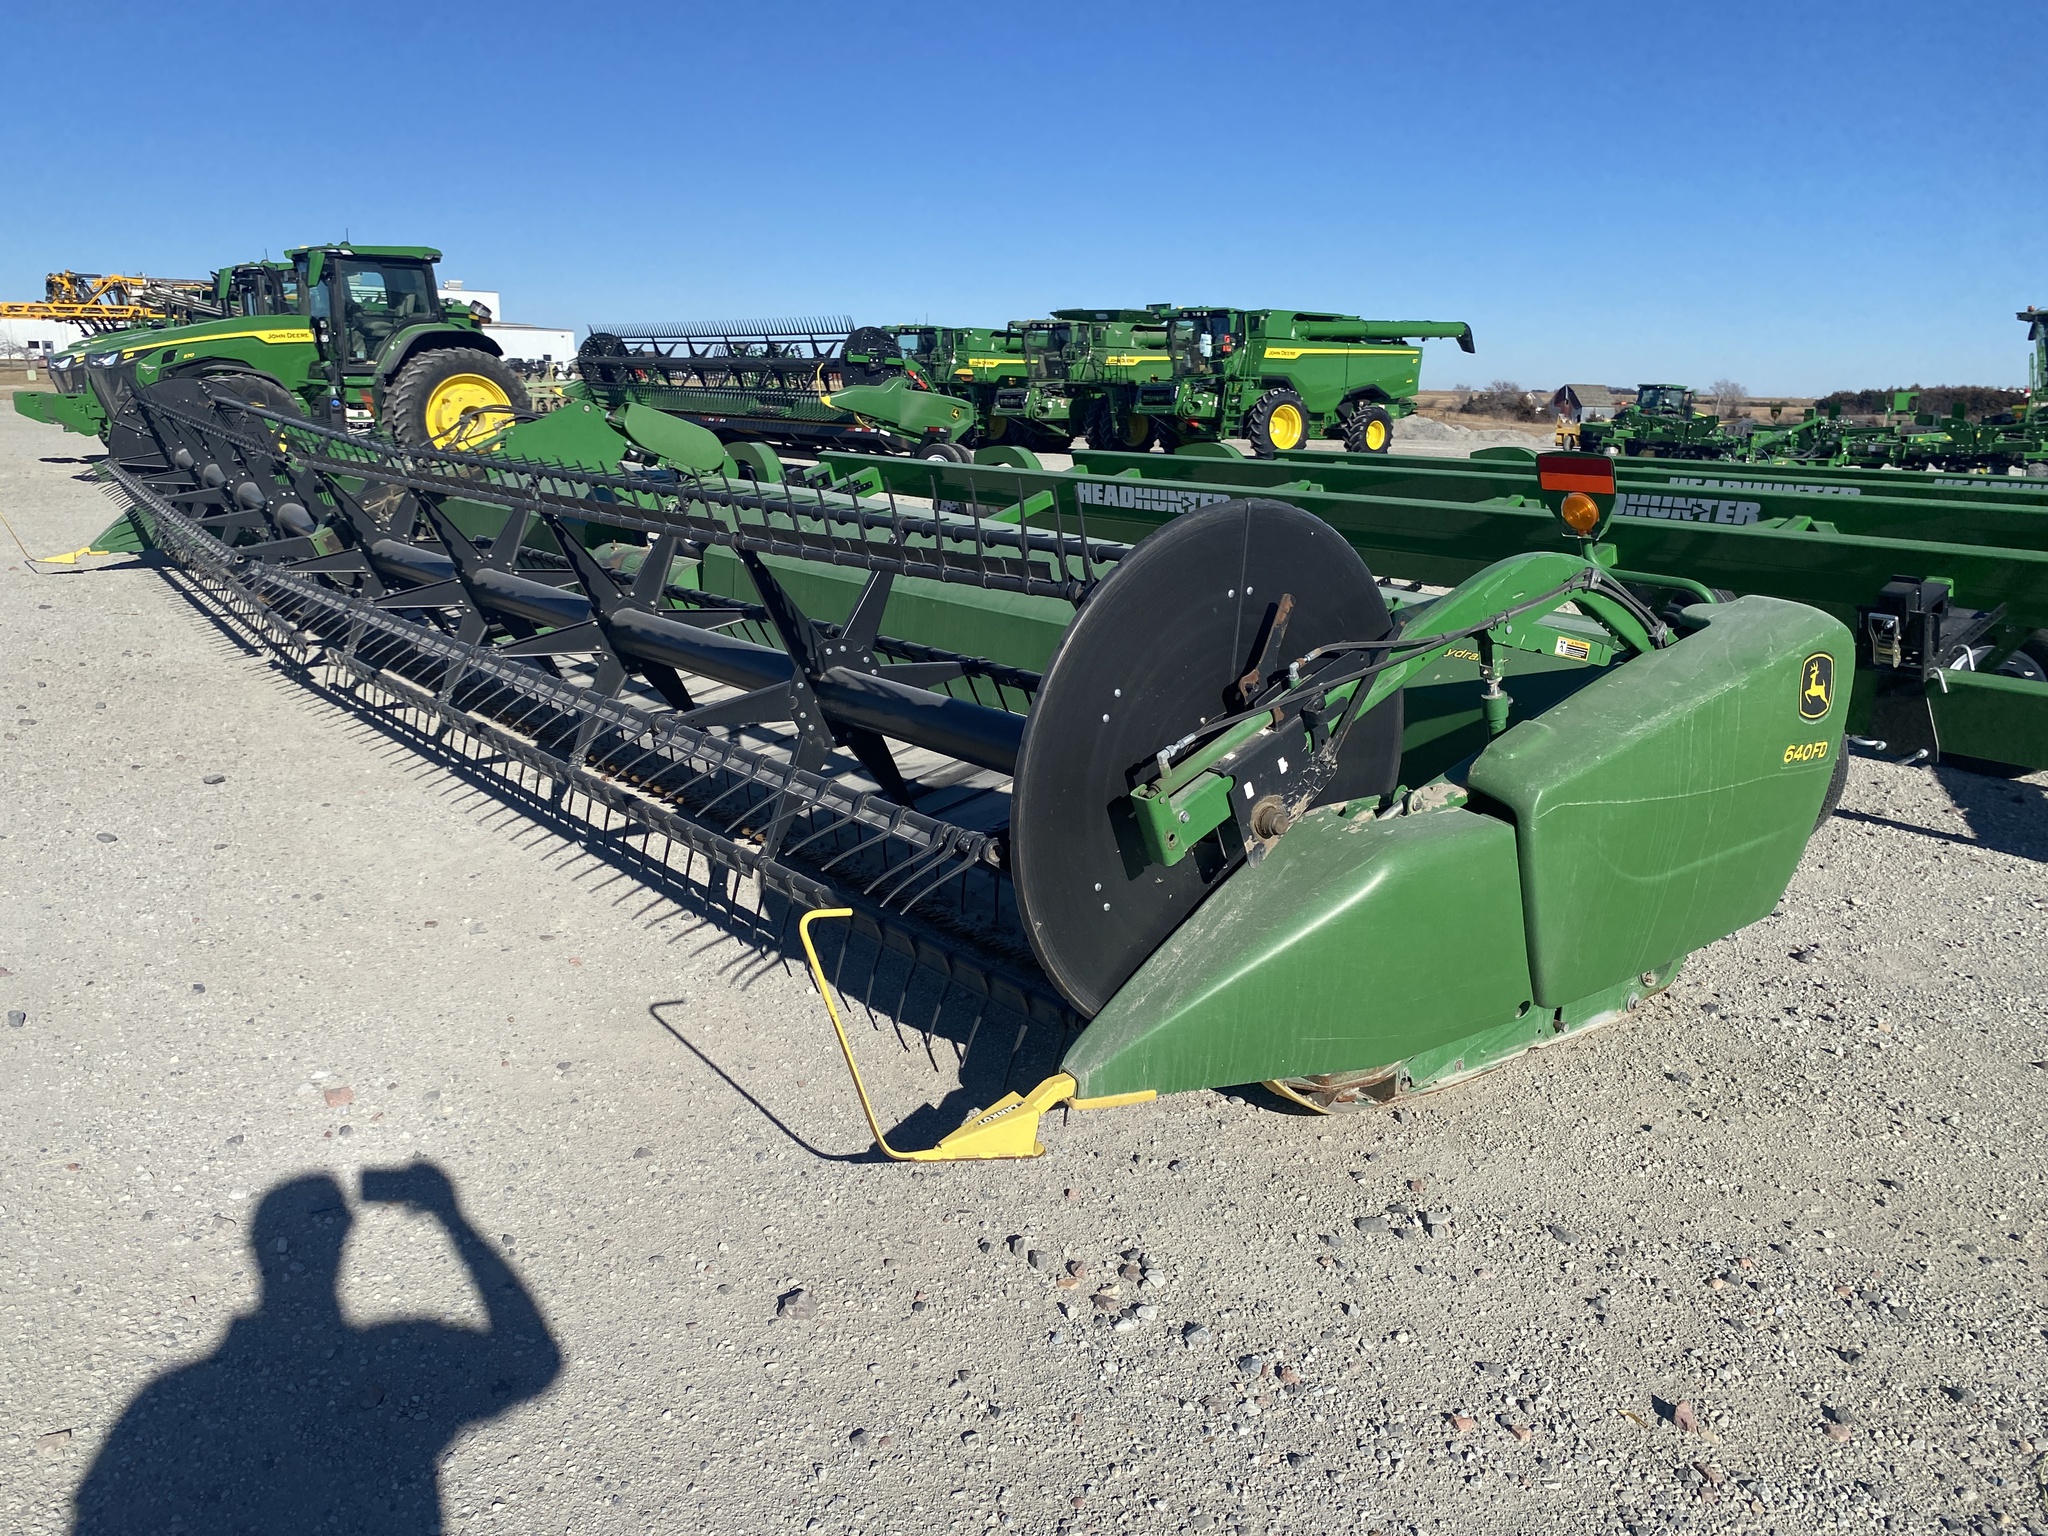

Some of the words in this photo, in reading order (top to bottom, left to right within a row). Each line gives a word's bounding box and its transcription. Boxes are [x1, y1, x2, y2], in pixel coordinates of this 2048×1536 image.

[1615, 493, 1762, 525] DHUNTER
[1443, 647, 1480, 662] ydra
[1783, 741, 1828, 763] 640FD
[976, 1103, 1019, 1127] LANKOT
